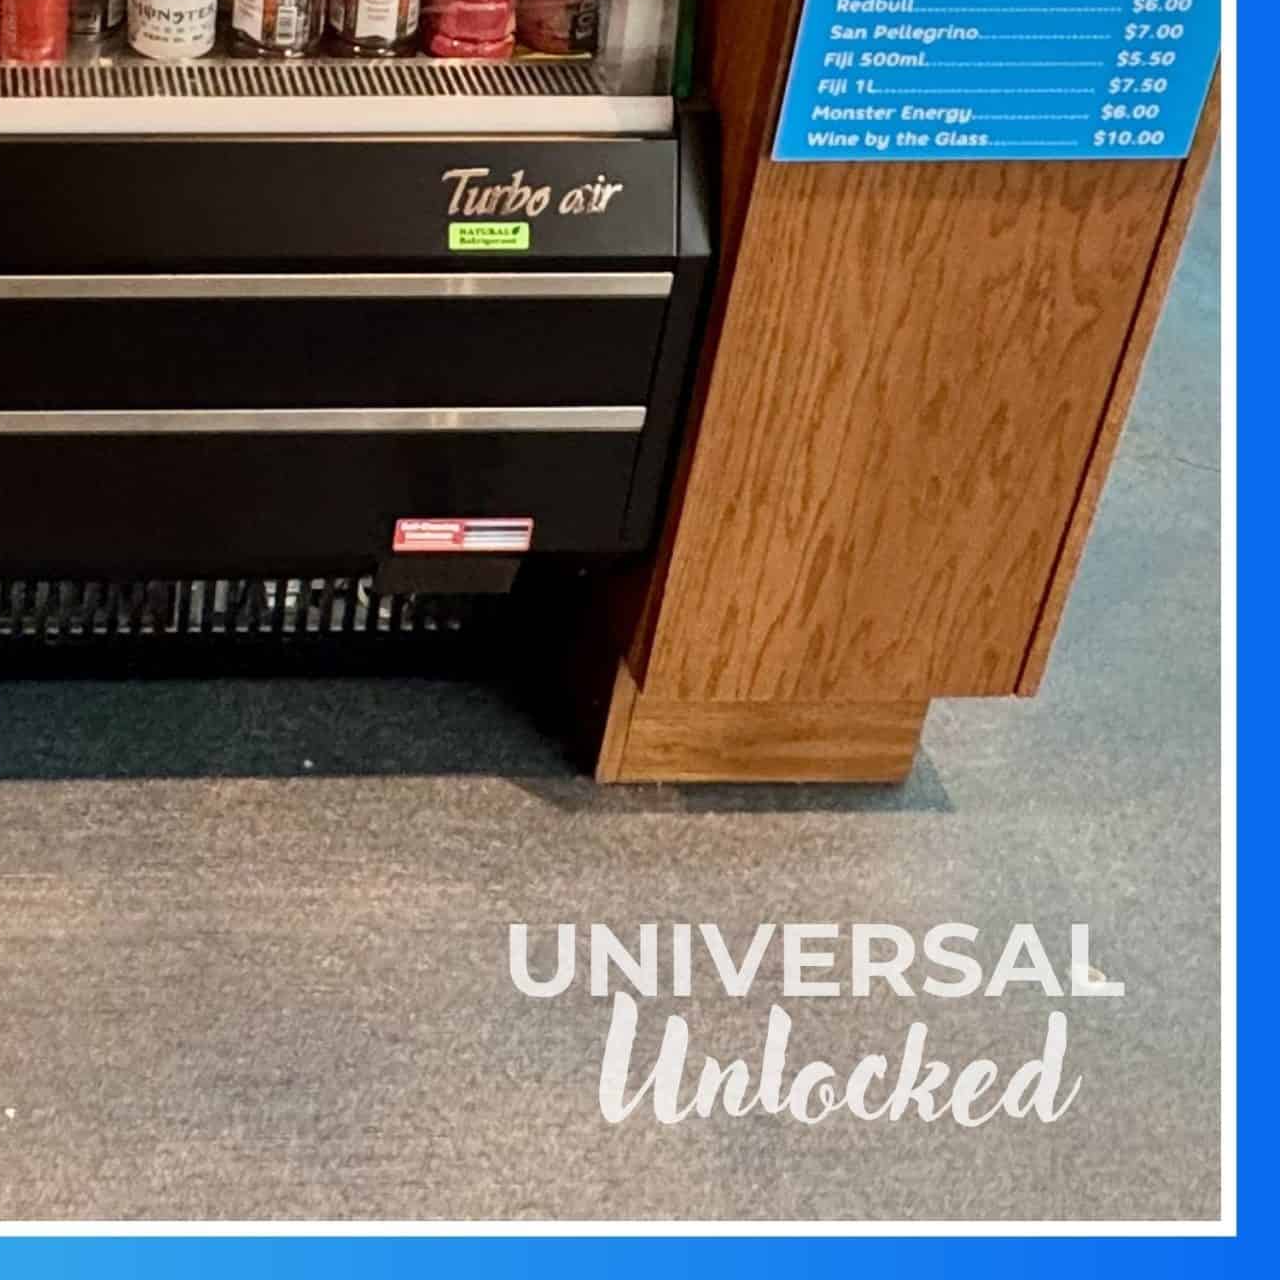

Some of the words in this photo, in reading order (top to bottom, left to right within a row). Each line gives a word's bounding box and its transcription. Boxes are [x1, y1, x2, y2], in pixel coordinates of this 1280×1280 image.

[831, 25, 867, 40] San
[873, 25, 979, 44] Pellegrino
[1125, 23, 1184, 41] $7.00
[824, 52, 853, 69] Fiji
[860, 52, 927, 67] 500ml
[1117, 50, 1175, 67] $5.50
[818, 79, 847, 96] Fiji
[856, 79, 875, 93] 1L
[1110, 77, 1167, 94] $7.50
[812, 106, 894, 120] Monster
[901, 105, 972, 124] Energy
[1102, 104, 1160, 120] $6.00
[807, 132, 859, 146] Wine
[864, 132, 890, 151] by
[896, 132, 929, 146] the
[935, 131, 988, 146] Glass
[1094, 130, 1165, 146] $10.00
[441, 167, 552, 217] Turbo
[558, 174, 624, 215] air
[460, 227, 509, 236] NATURAL
